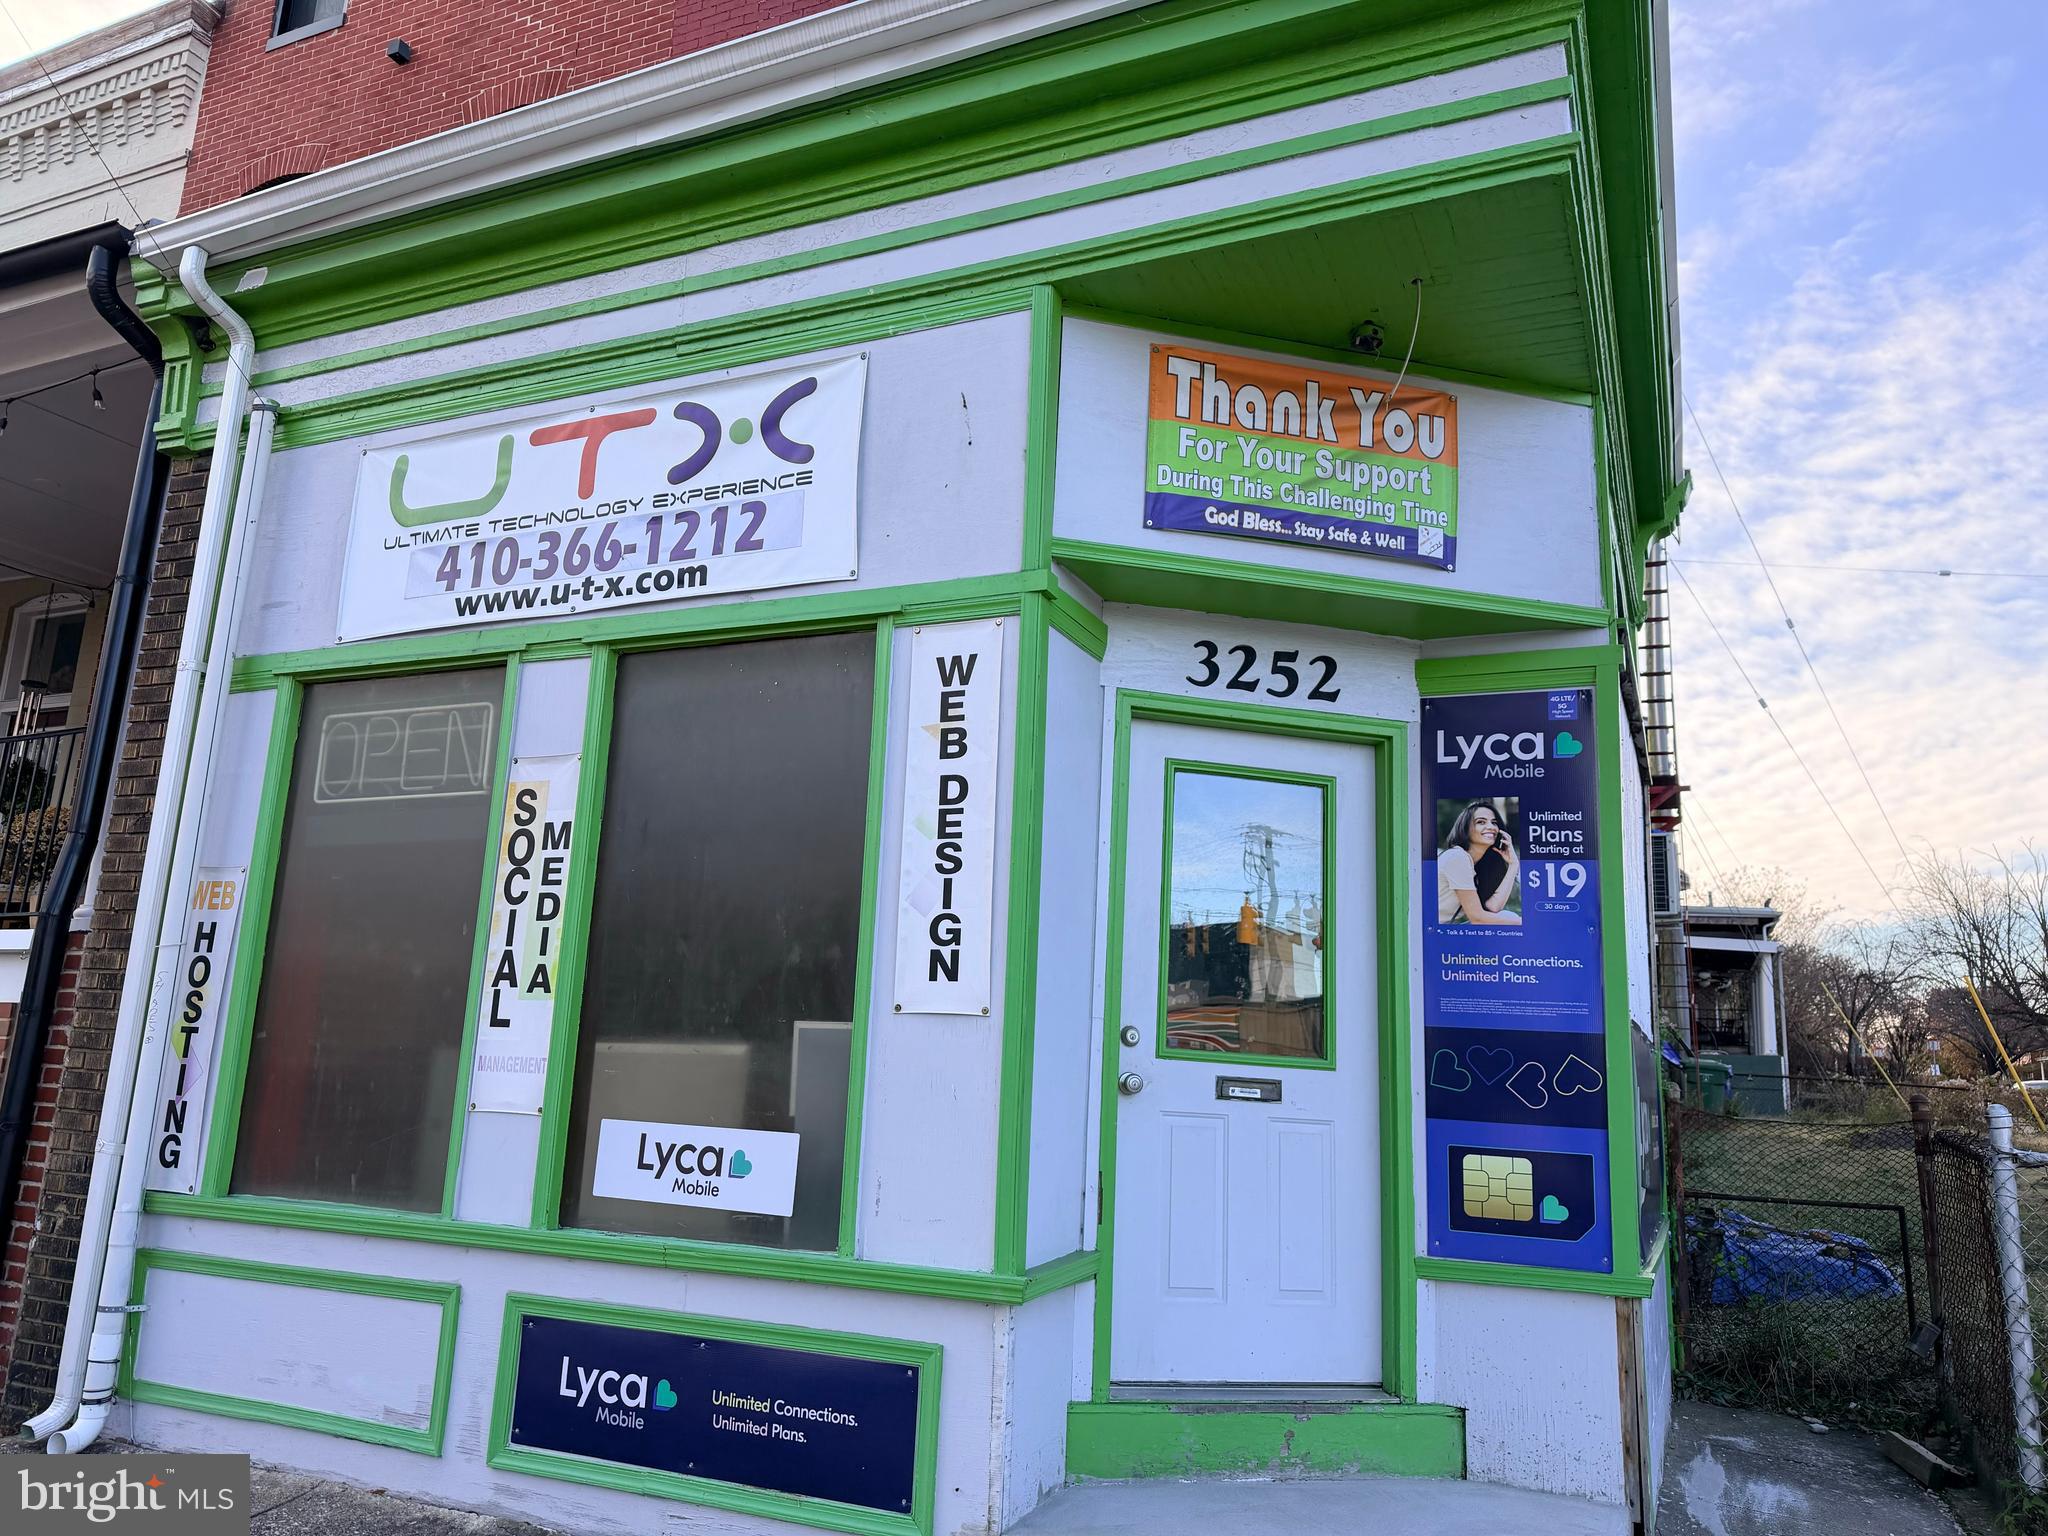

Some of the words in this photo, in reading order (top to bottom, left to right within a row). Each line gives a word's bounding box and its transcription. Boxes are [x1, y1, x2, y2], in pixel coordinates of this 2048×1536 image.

[1166, 354, 1339, 443] Thank
[1348, 386, 1446, 459] You
[1178, 426, 1228, 463] For
[1236, 435, 1307, 475] Your
[1314, 448, 1433, 496] Support
[383, 522, 481, 551] ULTIMATE
[488, 496, 644, 534] TECHNOLOGY
[652, 469, 815, 509] EXPERIENCE
[1156, 463, 1224, 498] During
[1228, 474, 1273, 501] This
[1279, 482, 1396, 523] Challenging
[1401, 499, 1449, 528] Time
[434, 499, 769, 594] 410-366-1212
[1204, 506, 1239, 529] God
[1242, 511, 1293, 536] Bless...
[1294, 521, 1325, 542] Stay
[1328, 526, 1358, 545] Safe
[1360, 530, 1372, 546] &
[1375, 532, 1406, 551] Well
[454, 562, 709, 617] www.u-t-x.com
[1185, 640, 1342, 703] 3252
[936, 652, 978, 760] WEB
[321, 710, 490, 797] OPEN
[1436, 730, 1546, 770] Lyca
[1484, 764, 1546, 780] Mobile
[1529, 811, 1582, 821] Unlimited
[1529, 826, 1583, 842] Plans
[1529, 844, 1570, 856] Starting
[1572, 845, 1584, 854] at
[928, 773, 969, 983] DESIGN
[489, 788, 537, 1029] SOCIAL
[526, 821, 572, 994] MEDIA
[1554, 903, 1570, 912] days
[1441, 953, 1499, 966] Unlimited
[1502, 954, 1584, 968] Connections.
[1441, 970, 1499, 982] Unlimited
[1503, 971, 1540, 984] Plans.
[158, 921, 218, 1170] HOSTING
[478, 1055, 548, 1075] MANAGEMENT
[637, 1132, 724, 1179] Lyca
[671, 1177, 720, 1197] Mobile
[559, 1355, 649, 1408] Lyca
[595, 1405, 645, 1431] Mobile
[712, 1389, 771, 1414] Unlimited
[773, 1399, 859, 1427] Connections.
[712, 1413, 769, 1437] Unlimited
[771, 1423, 807, 1443] Plans.
